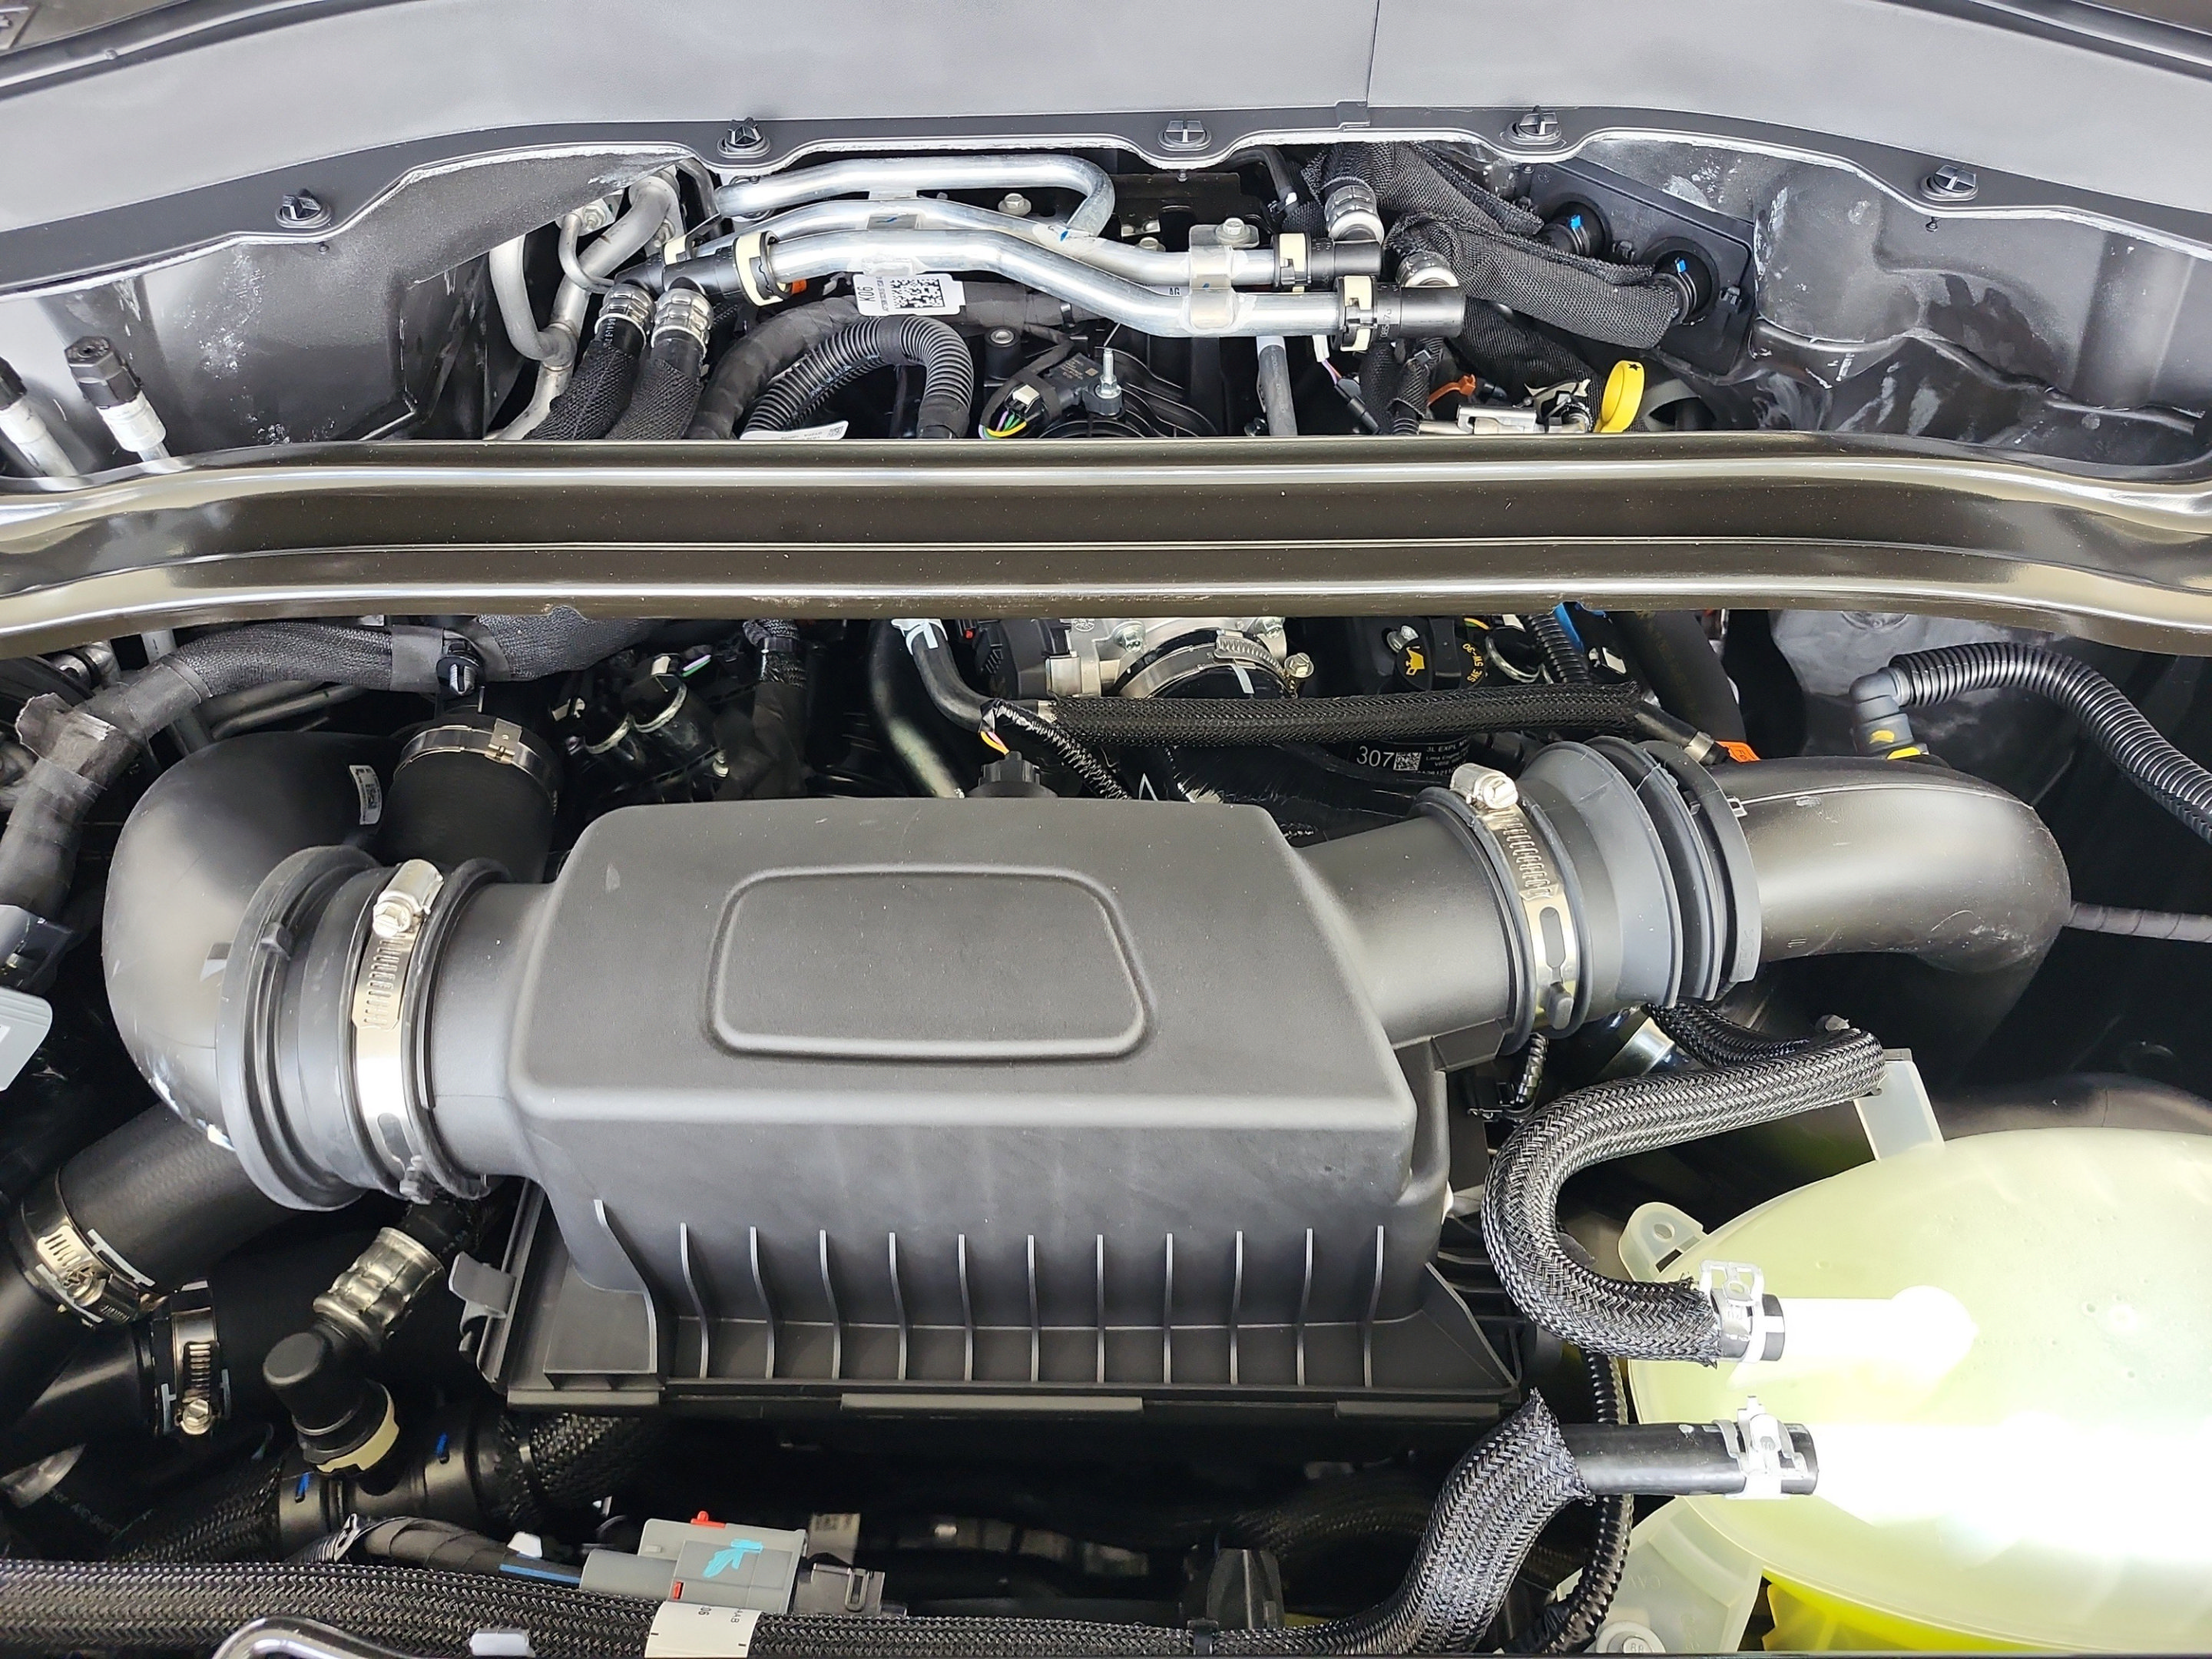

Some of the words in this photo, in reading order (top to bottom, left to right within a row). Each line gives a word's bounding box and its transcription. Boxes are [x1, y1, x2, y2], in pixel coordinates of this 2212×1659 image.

[857, 286, 876, 302] K06
[1462, 643, 1484, 667] 5W-30
[1467, 669, 1483, 683] SAE
[1356, 745, 1395, 767] 307
